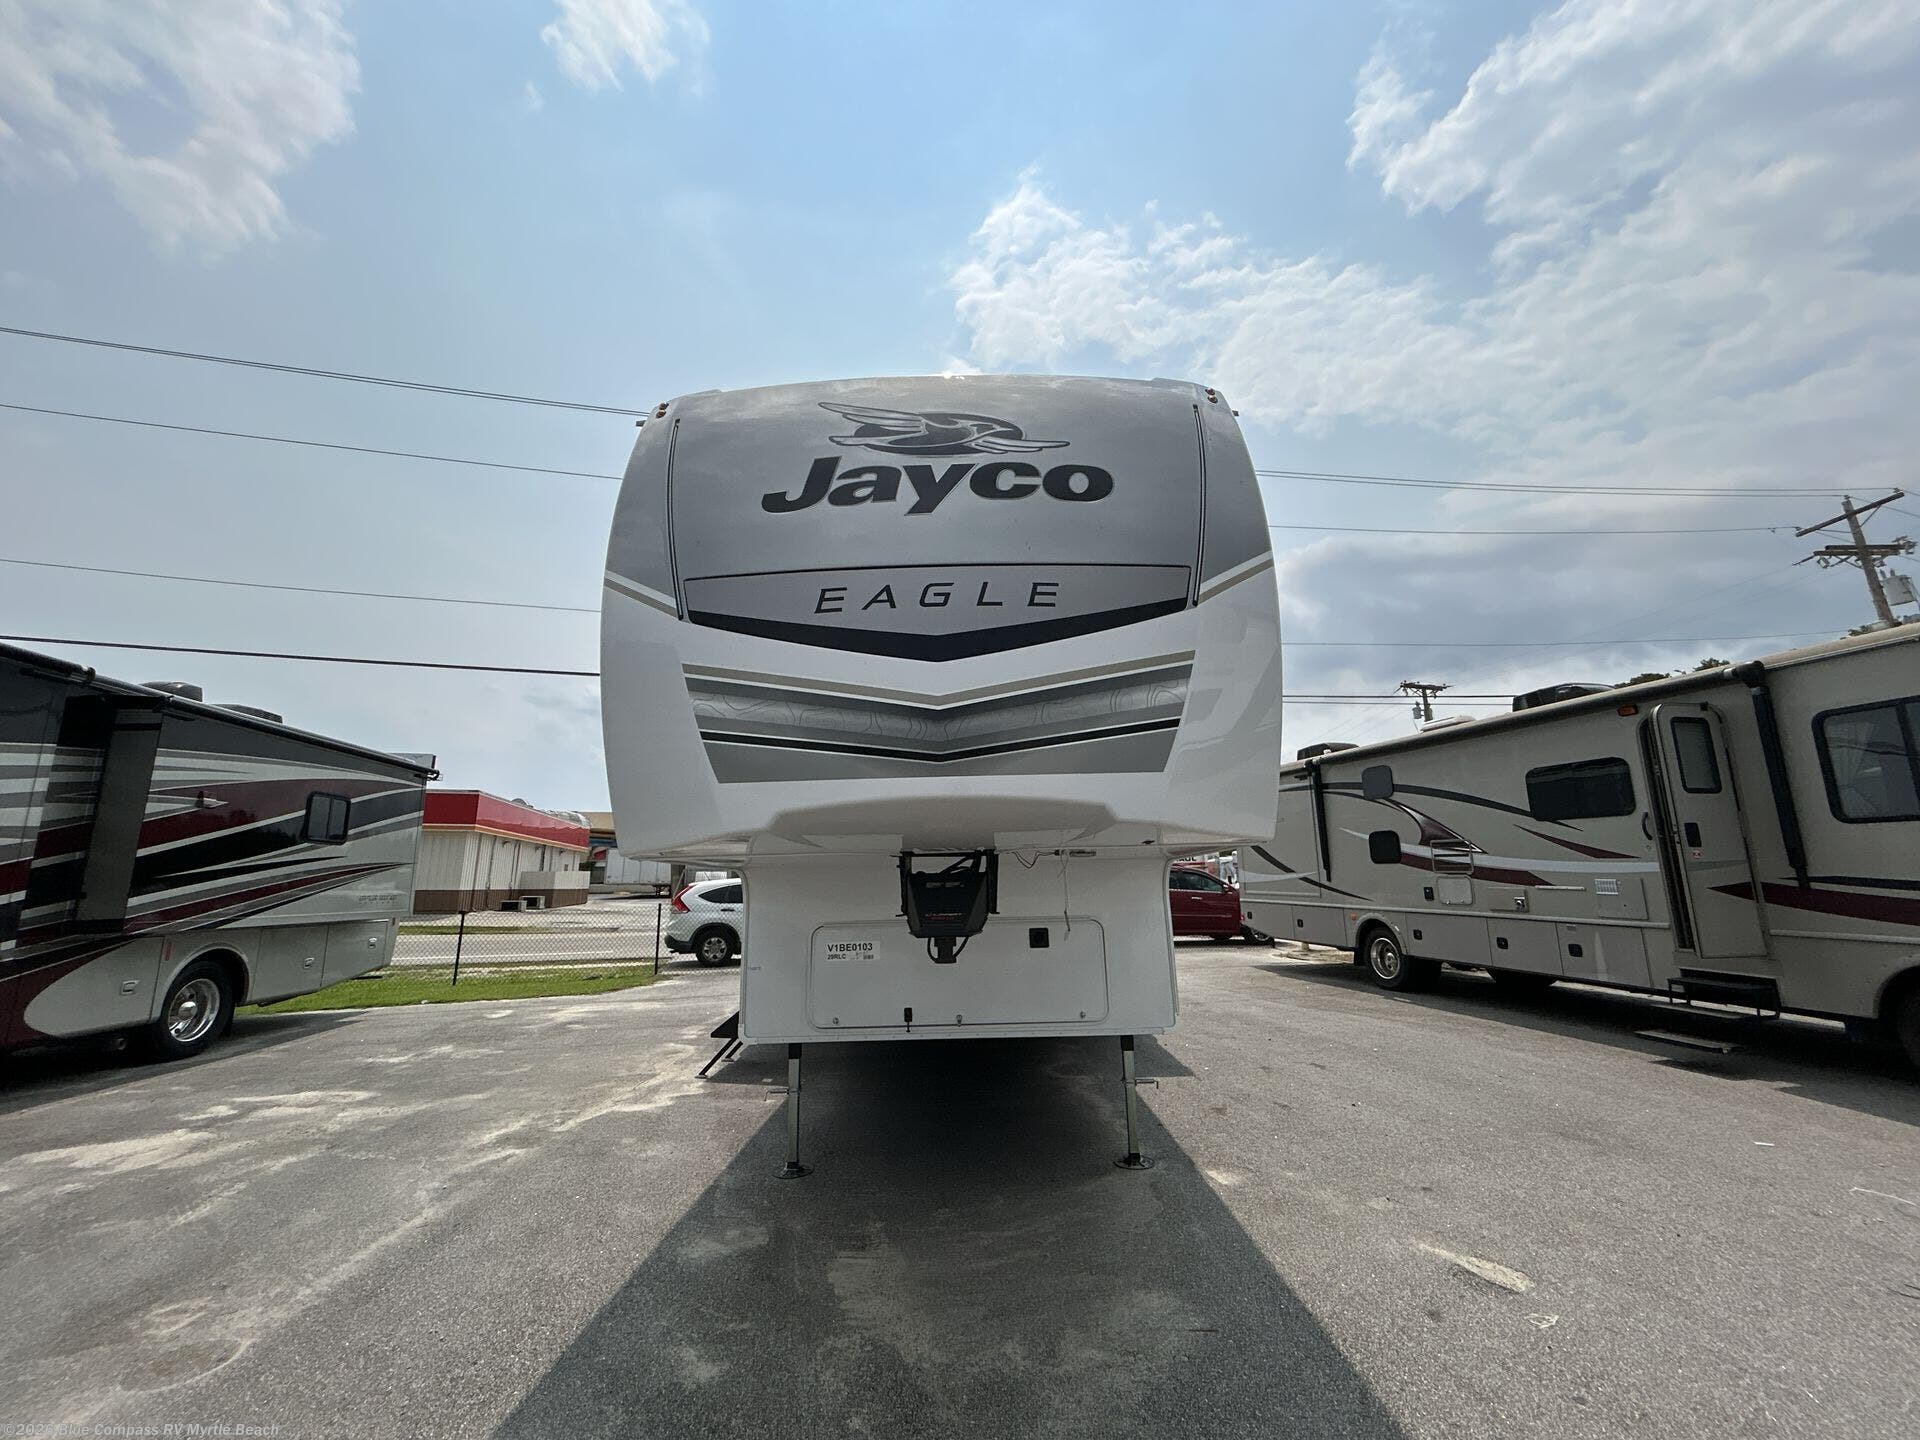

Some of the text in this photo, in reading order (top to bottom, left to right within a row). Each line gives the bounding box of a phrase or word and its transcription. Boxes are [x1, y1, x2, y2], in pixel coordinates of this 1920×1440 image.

[761, 456, 1114, 516] Jayco
[814, 581, 1060, 614] EAGLE
[827, 943, 873, 952] V1BE0103
